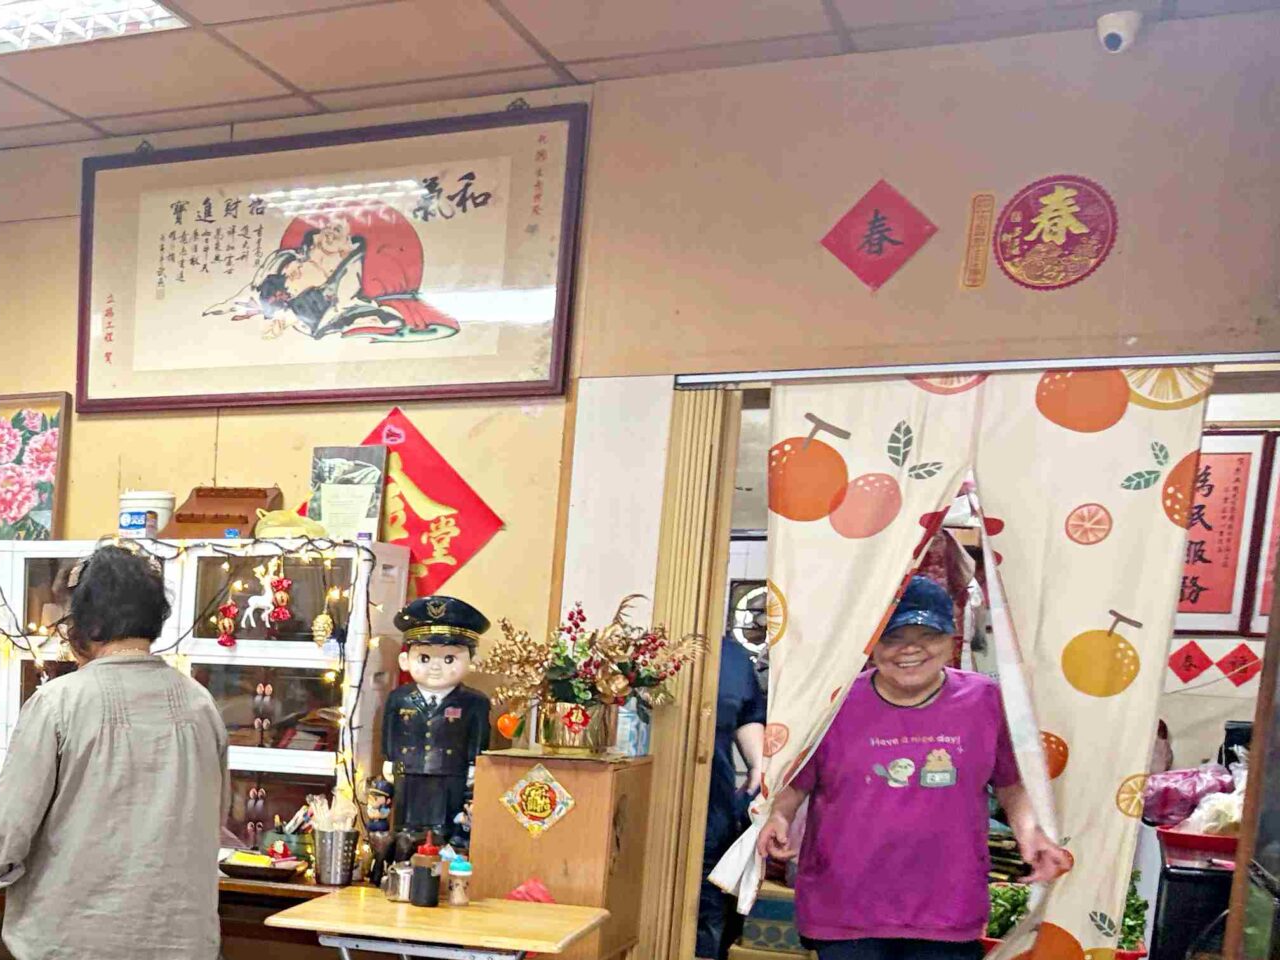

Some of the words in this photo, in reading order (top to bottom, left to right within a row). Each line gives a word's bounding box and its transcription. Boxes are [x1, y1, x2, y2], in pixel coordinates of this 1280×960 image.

[856, 208, 904, 257] 春
[1024, 185, 1090, 246] 春
[1179, 465, 1215, 604] 為民服務
[870, 737, 899, 747] Have
